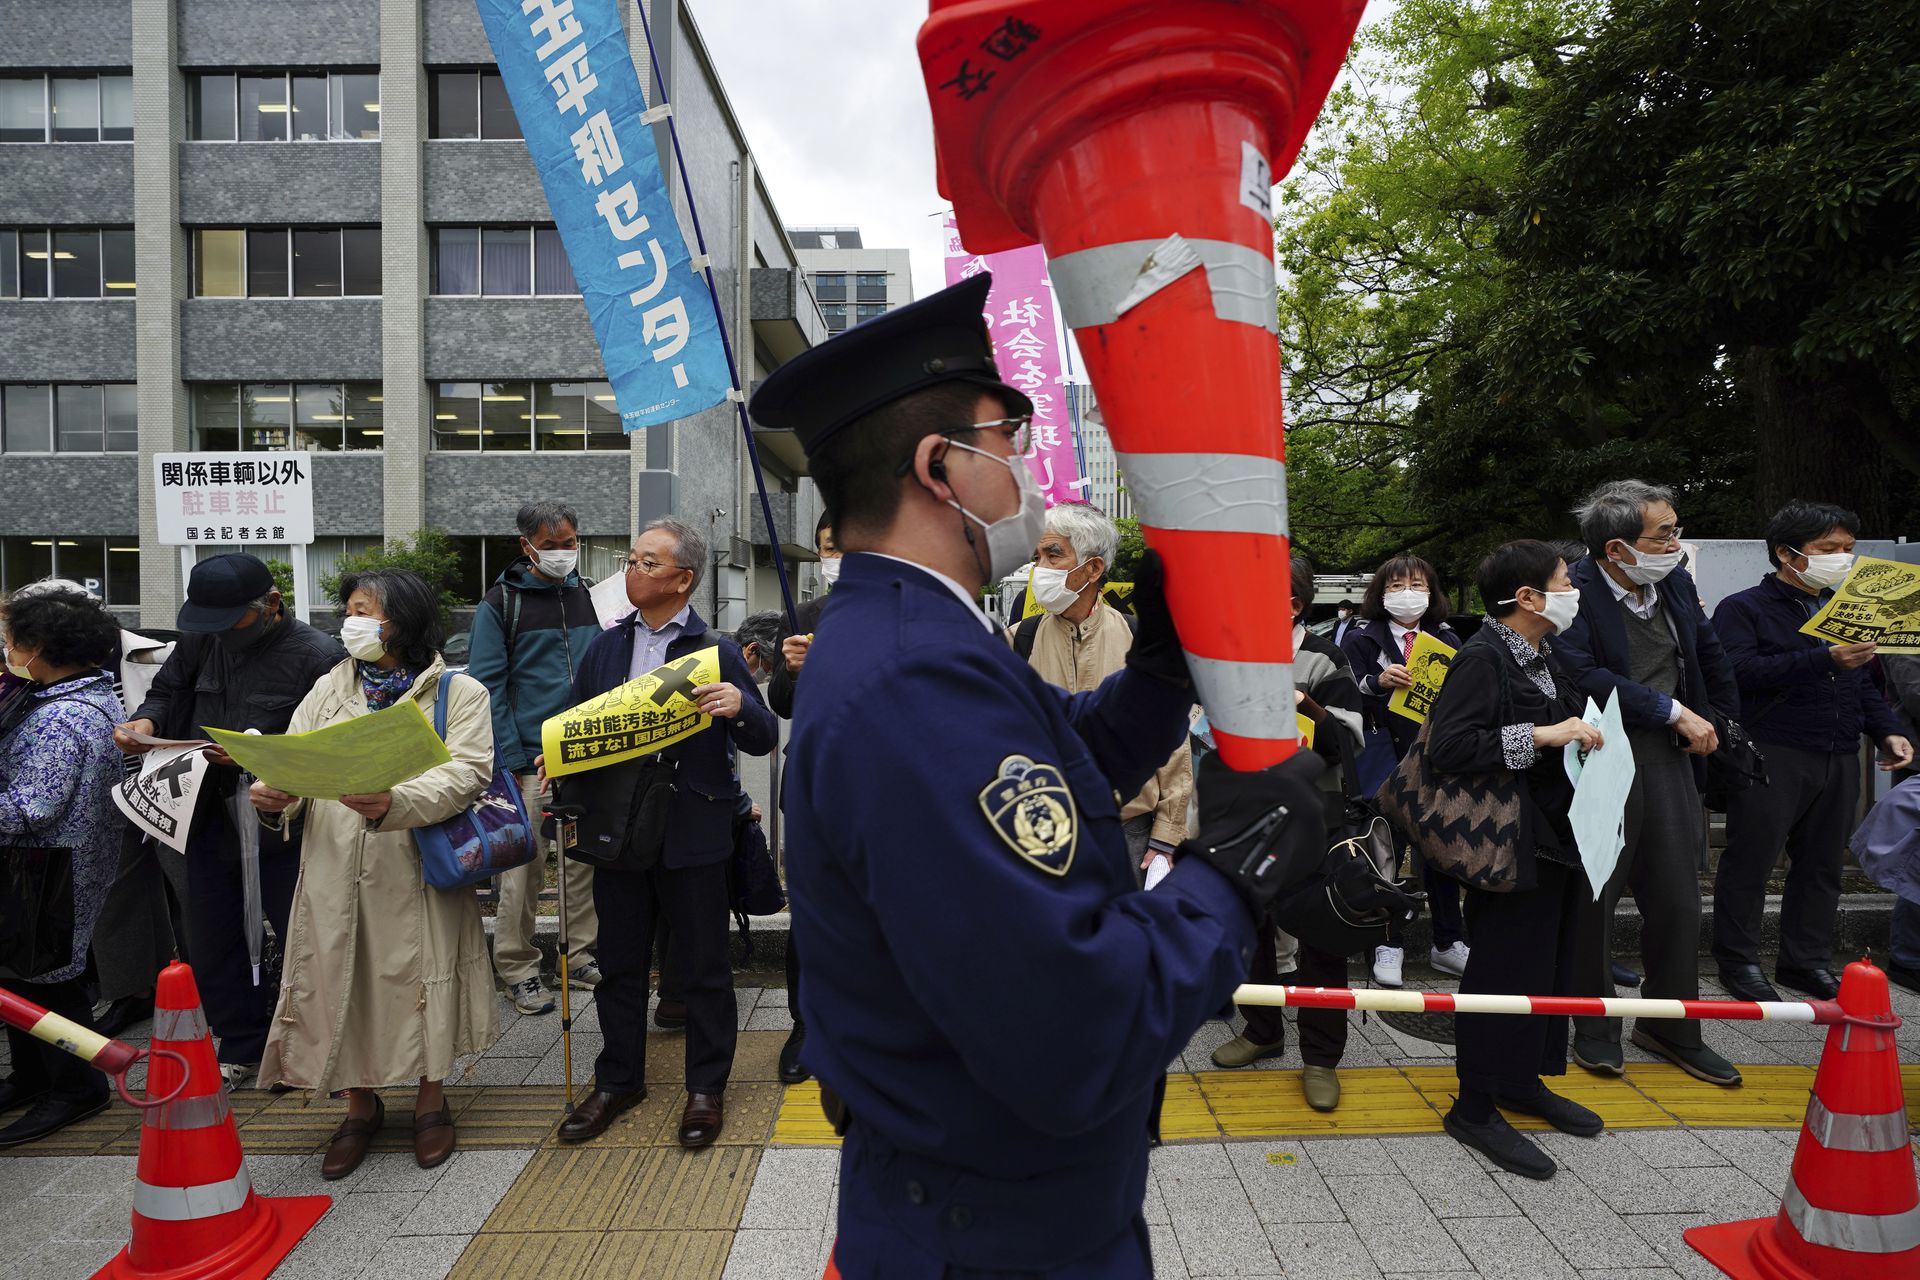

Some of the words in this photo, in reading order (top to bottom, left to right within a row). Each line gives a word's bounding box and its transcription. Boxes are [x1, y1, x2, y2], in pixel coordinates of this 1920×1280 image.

[161, 460, 305, 487] 関係車輌以外
[182, 490, 286, 516] 駐車禁止
[186, 526, 285, 540] 国会記者会館
[563, 708, 677, 739] 放射能汚染水
